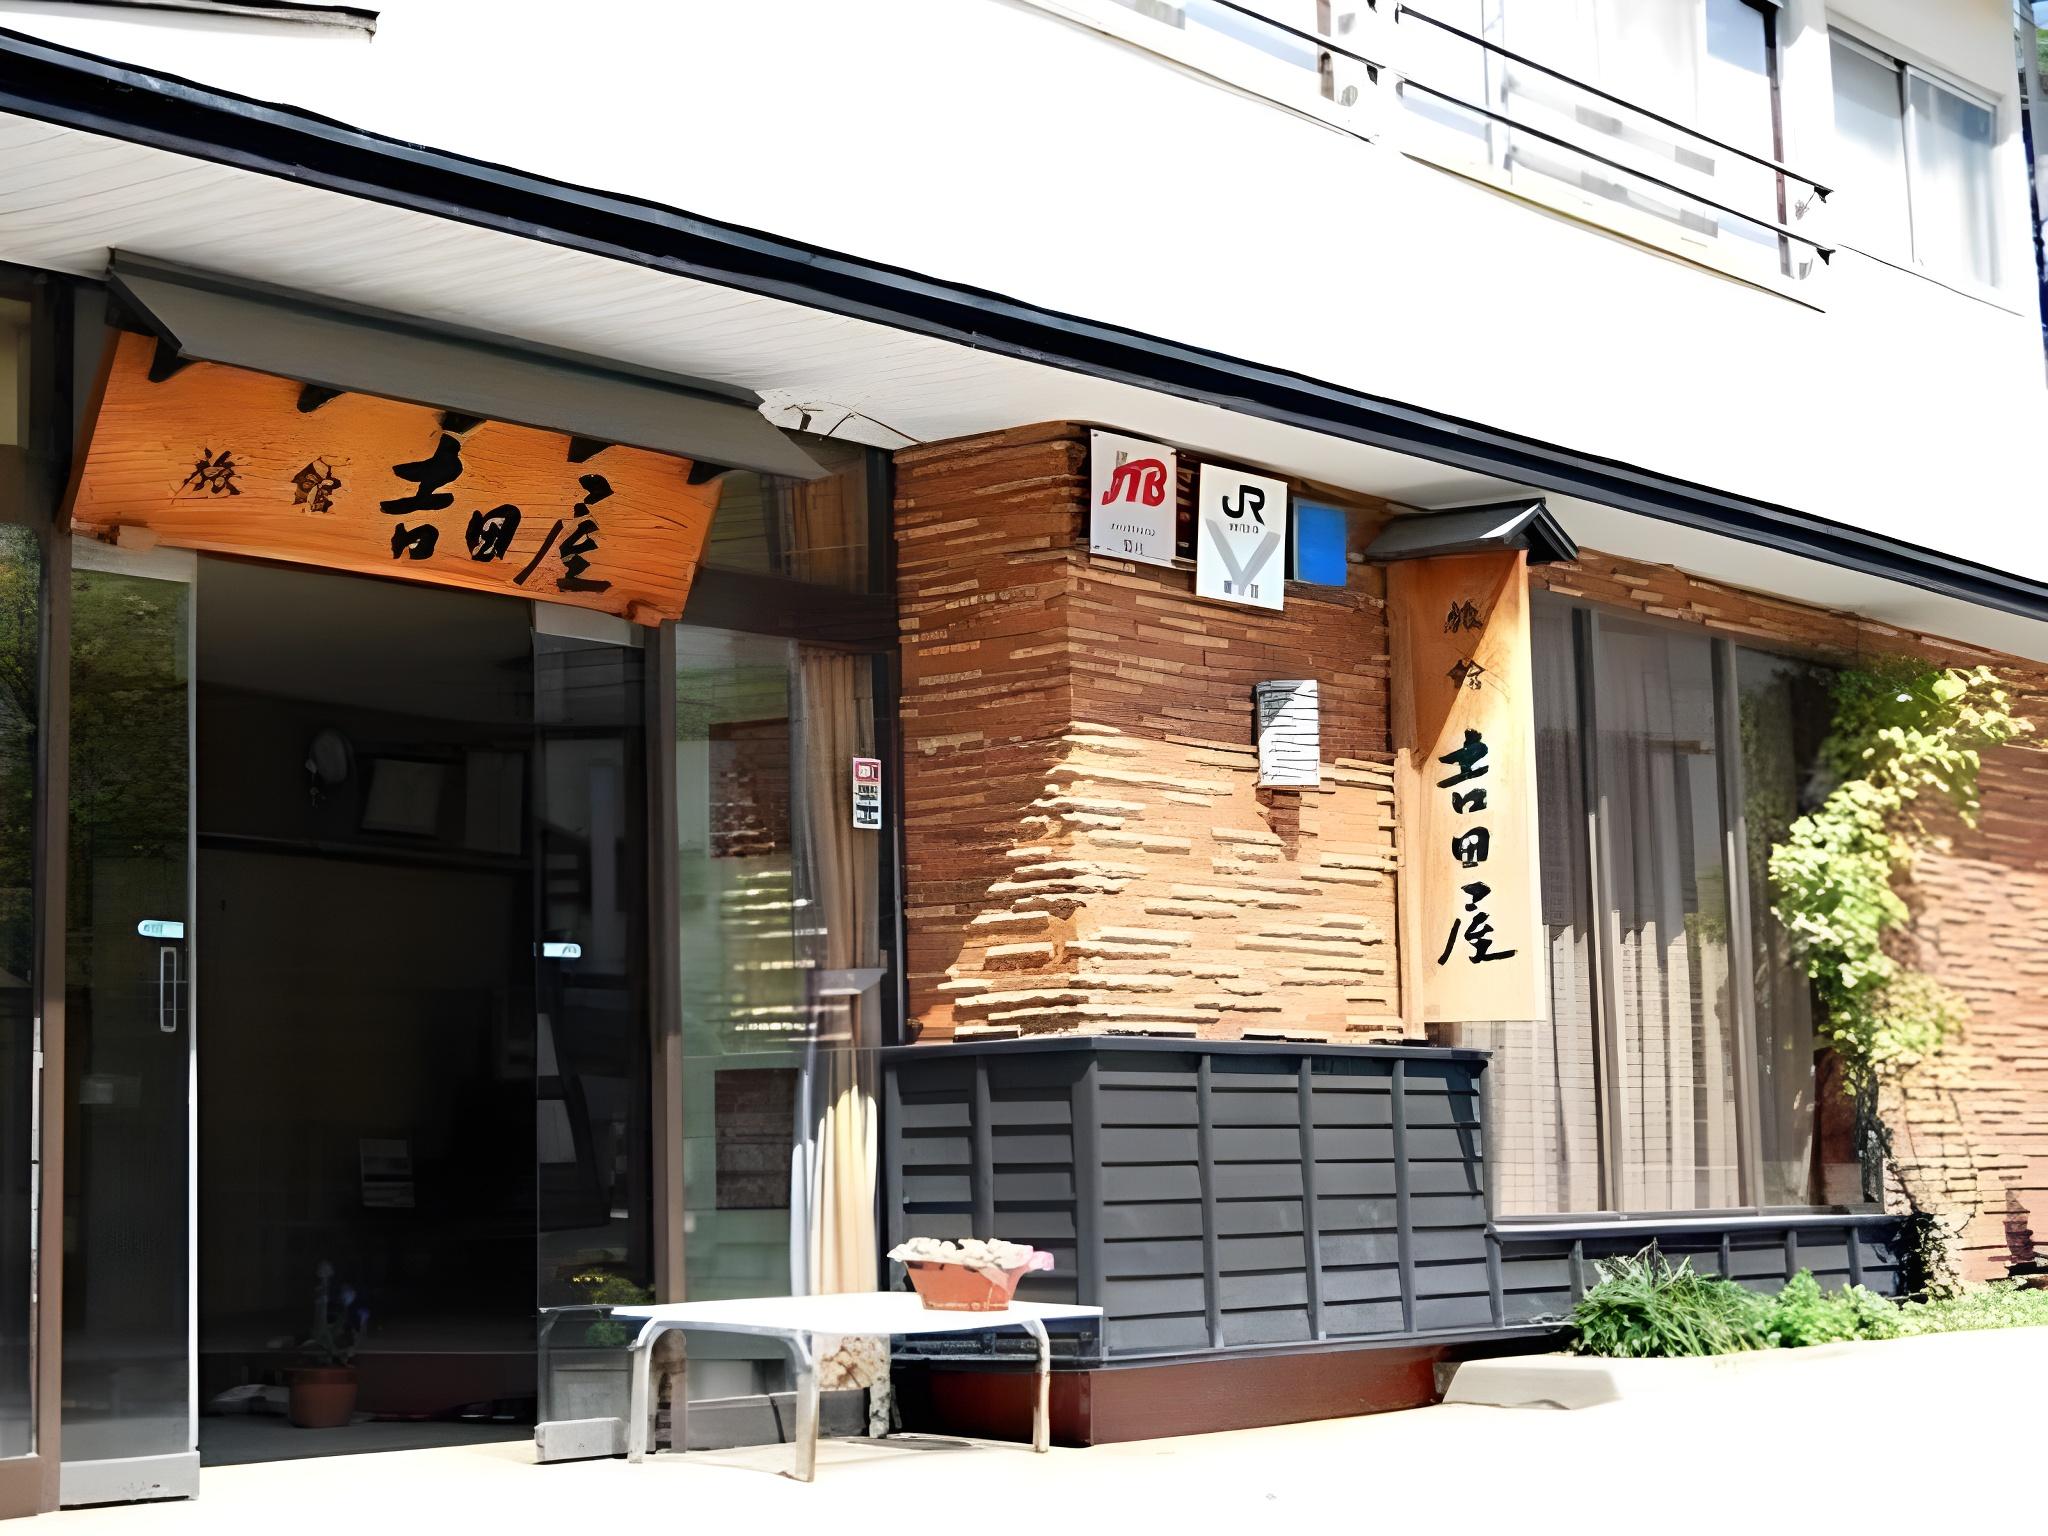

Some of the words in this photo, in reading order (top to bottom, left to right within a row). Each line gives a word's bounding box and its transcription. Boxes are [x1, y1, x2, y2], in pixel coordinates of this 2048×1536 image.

[379, 432, 615, 593] 吉田屋
[1101, 458, 1167, 507] JTB
[1221, 484, 1265, 526] JR
[1435, 727, 1518, 966] 吉田屋
